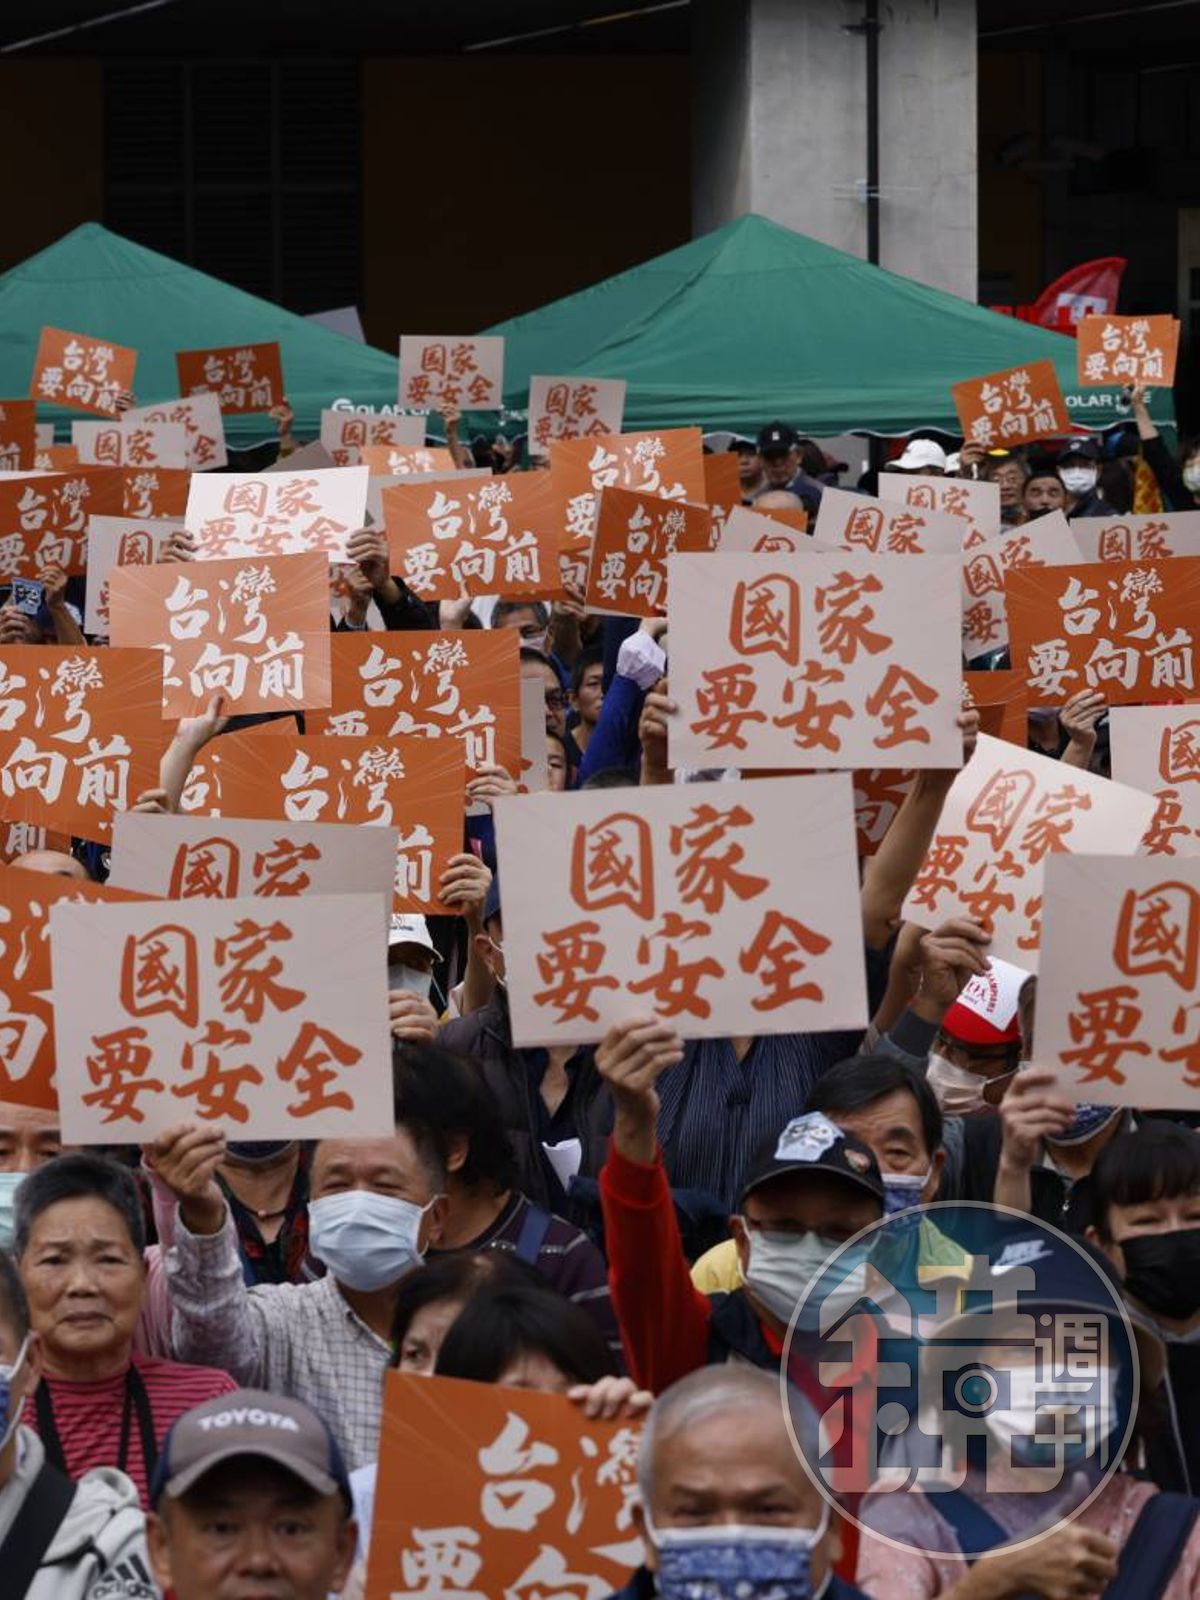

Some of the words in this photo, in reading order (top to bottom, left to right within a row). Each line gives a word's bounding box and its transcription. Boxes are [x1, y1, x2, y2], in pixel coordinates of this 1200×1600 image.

[64, 340, 114, 381] 台灣
[421, 343, 478, 374] 國家
[1101, 320, 1150, 353] 台灣
[203, 350, 256, 384] 台灣
[1084, 349, 1163, 381] 要向前
[38, 367, 121, 413] 要向前
[407, 375, 493, 405] 要安全
[545, 383, 598, 416] 國家
[980, 370, 1032, 413] 台灣
[1065, 394, 1113, 407] OLAR
[341, 419, 398, 448] 國家
[971, 399, 1058, 447] 要向前
[95, 430, 158, 465] 國家
[388, 450, 433, 475] 台灣
[588, 436, 666, 491] 台灣
[17, 479, 90, 532] 台灣
[123, 472, 159, 518] 灣
[222, 478, 322, 517] 國家
[427, 481, 513, 541] 台灣
[198, 516, 348, 556] 要安全
[626, 504, 687, 553] 台灣
[844, 506, 926, 554] 國家
[1098, 521, 1174, 561] 國家
[404, 531, 540, 593] 要向前
[596, 553, 667, 607] 要向
[165, 565, 277, 644] 台灣
[729, 571, 893, 667] 國家
[1058, 568, 1163, 639] 台灣
[359, 638, 469, 714] 台灣
[1026, 628, 1195, 697] 要向前
[690, 660, 939, 752] 要安全
[280, 746, 406, 827] 台灣
[965, 768, 1092, 864] 國家
[168, 836, 321, 899] 國家
[570, 803, 770, 921] 國家
[120, 918, 307, 1029] 國家
[533, 910, 833, 1025] 要安全
[81, 1020, 362, 1125] 要安全
[197, 1408, 299, 1432] TOYOTA
[390, 1526, 614, 1600] 要向
